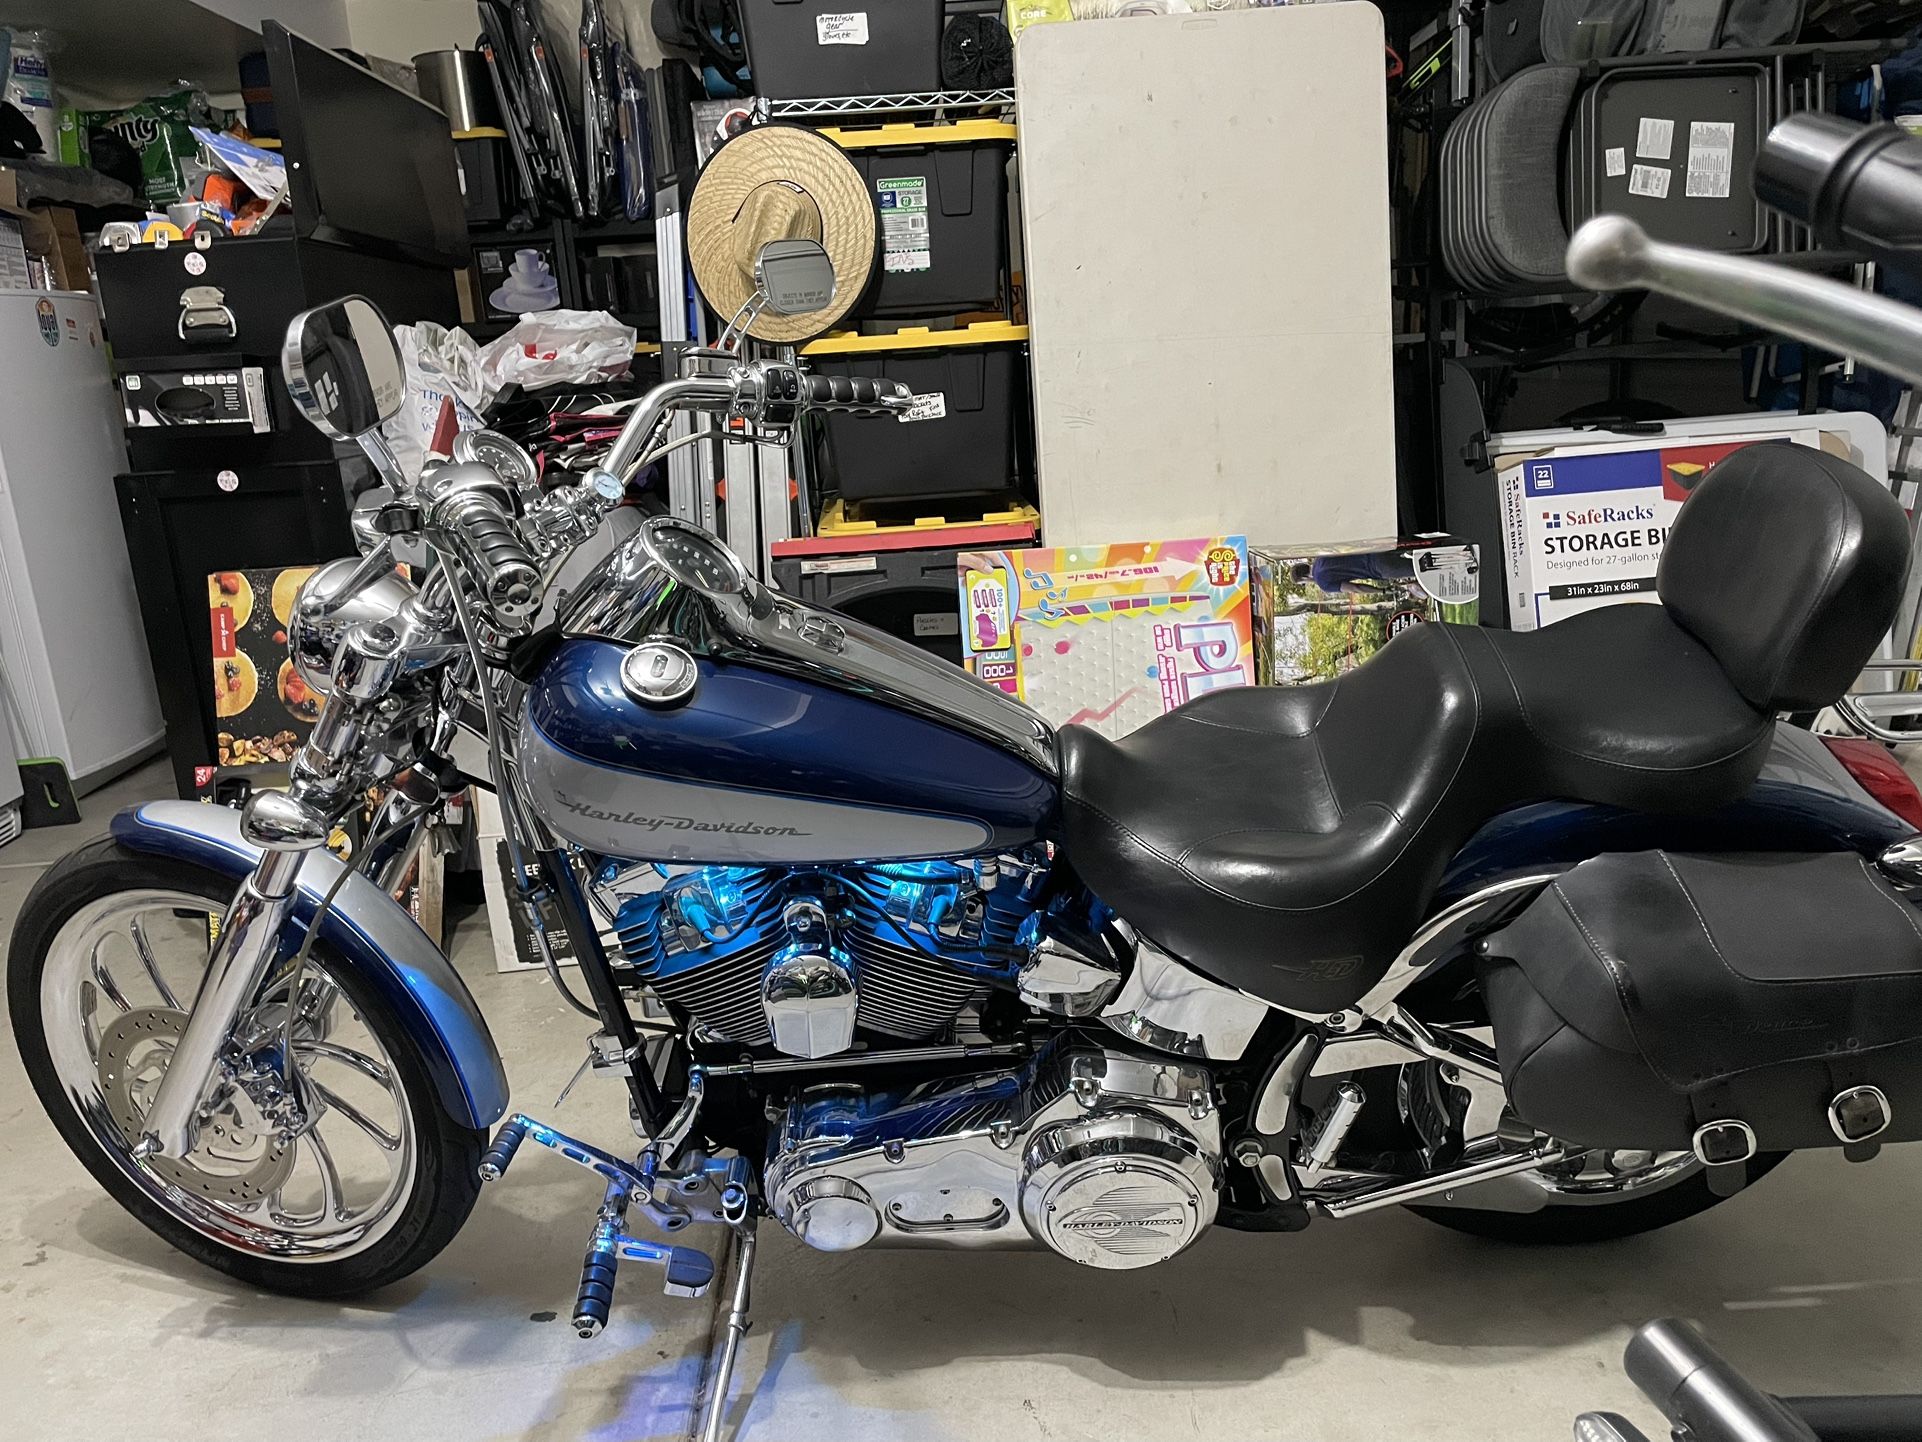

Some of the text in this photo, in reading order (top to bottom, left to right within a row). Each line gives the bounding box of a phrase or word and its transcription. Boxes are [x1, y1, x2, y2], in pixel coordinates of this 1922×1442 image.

[1021, 11, 1047, 20] CORE
[879, 180, 923, 189] Greenmade
[1538, 470, 1549, 479] 22
[1514, 493, 1524, 556] SafeRacks
[1566, 505, 1654, 526] SafeRacks
[1506, 480, 1515, 529] STORAGE
[1512, 552, 1520, 578] RACK
[1543, 529, 1642, 555] STORAGE
[1546, 558, 1589, 570] Designed
[1592, 556, 1603, 566] for
[1606, 552, 1649, 565] 27-gallon
[1567, 587, 1586, 596] 31in
[1594, 584, 1613, 593] 23in
[1620, 581, 1639, 591] 68in
[196, 768, 206, 782] 24
[553, 790, 813, 837] Harley-Davidson
